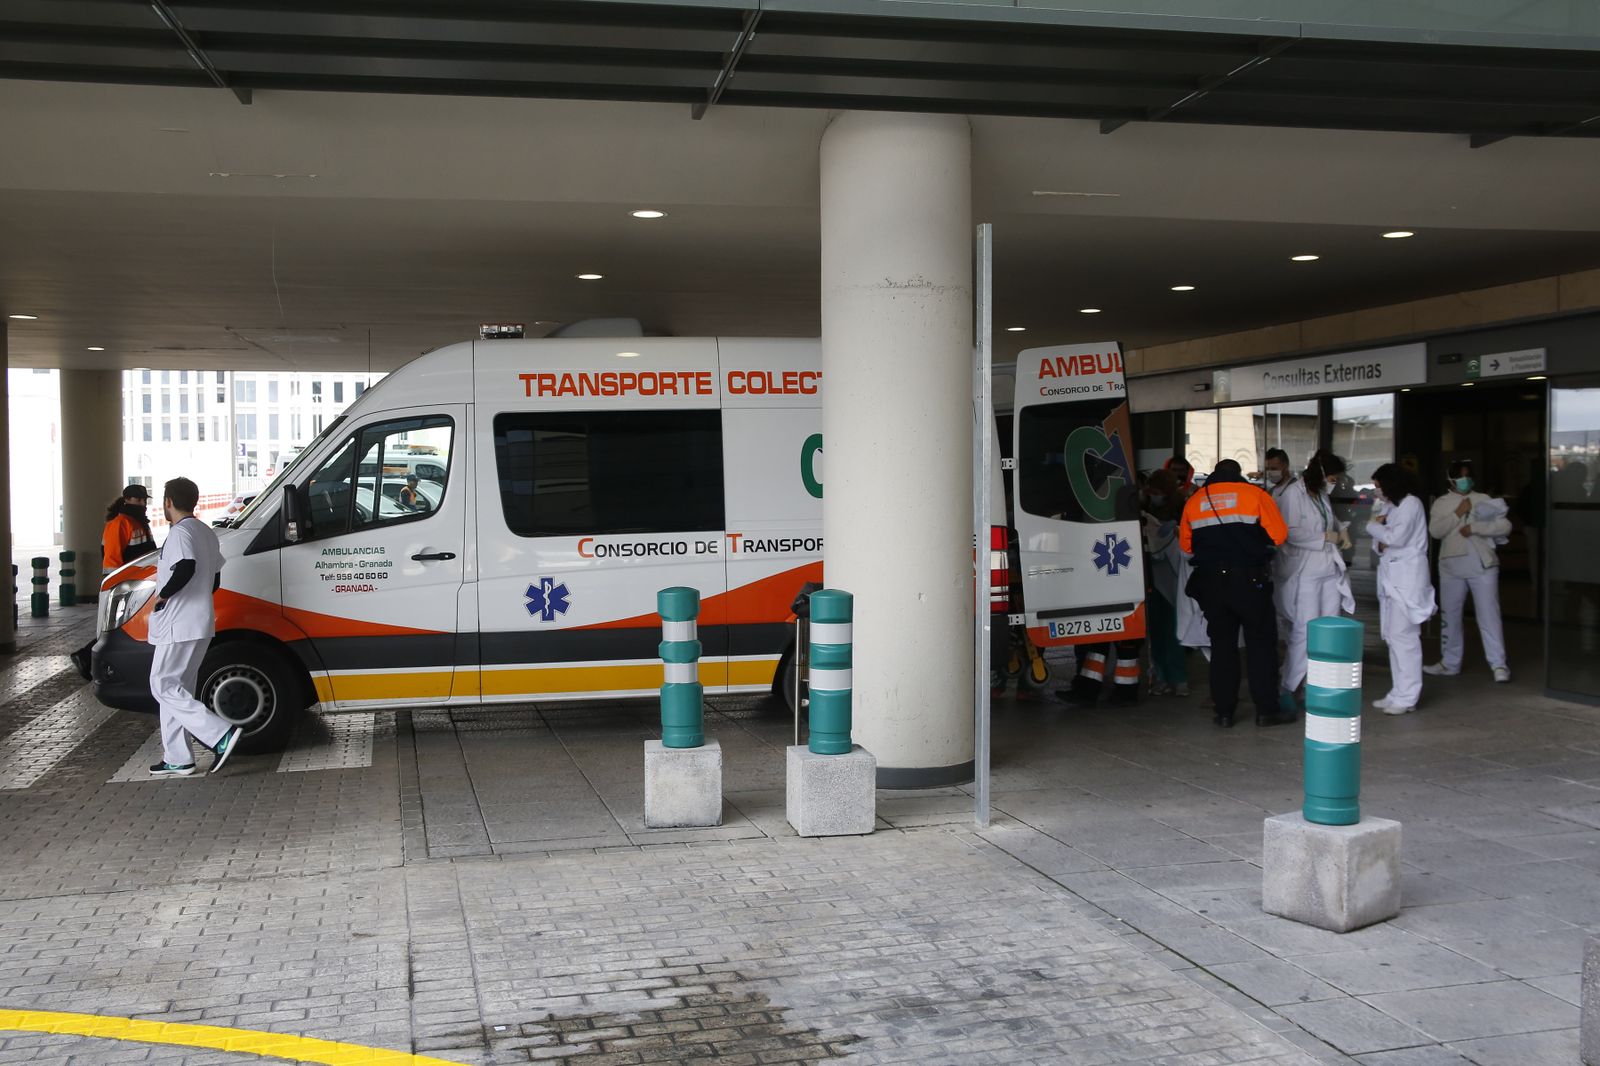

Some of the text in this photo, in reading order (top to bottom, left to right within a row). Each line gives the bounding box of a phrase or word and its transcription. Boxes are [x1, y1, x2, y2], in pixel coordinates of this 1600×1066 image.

[518, 371, 823, 397] TRANSPORTE COLEC
[1263, 363, 1382, 391] Consultas Externas
[1040, 384, 1090, 396] CONSORCIO
[321, 547, 385, 556] AMBULANCIAS
[577, 537, 688, 558] CONSORCIO
[694, 540, 719, 554] DE
[315, 561, 353, 569] Alhambra
[359, 560, 393, 568] Granada
[336, 573, 352, 581] 958
[365, 572, 376, 580] 60
[377, 572, 388, 580] 60
[1057, 621, 1092, 636] 8278
[1097, 617, 1122, 632] JZG
